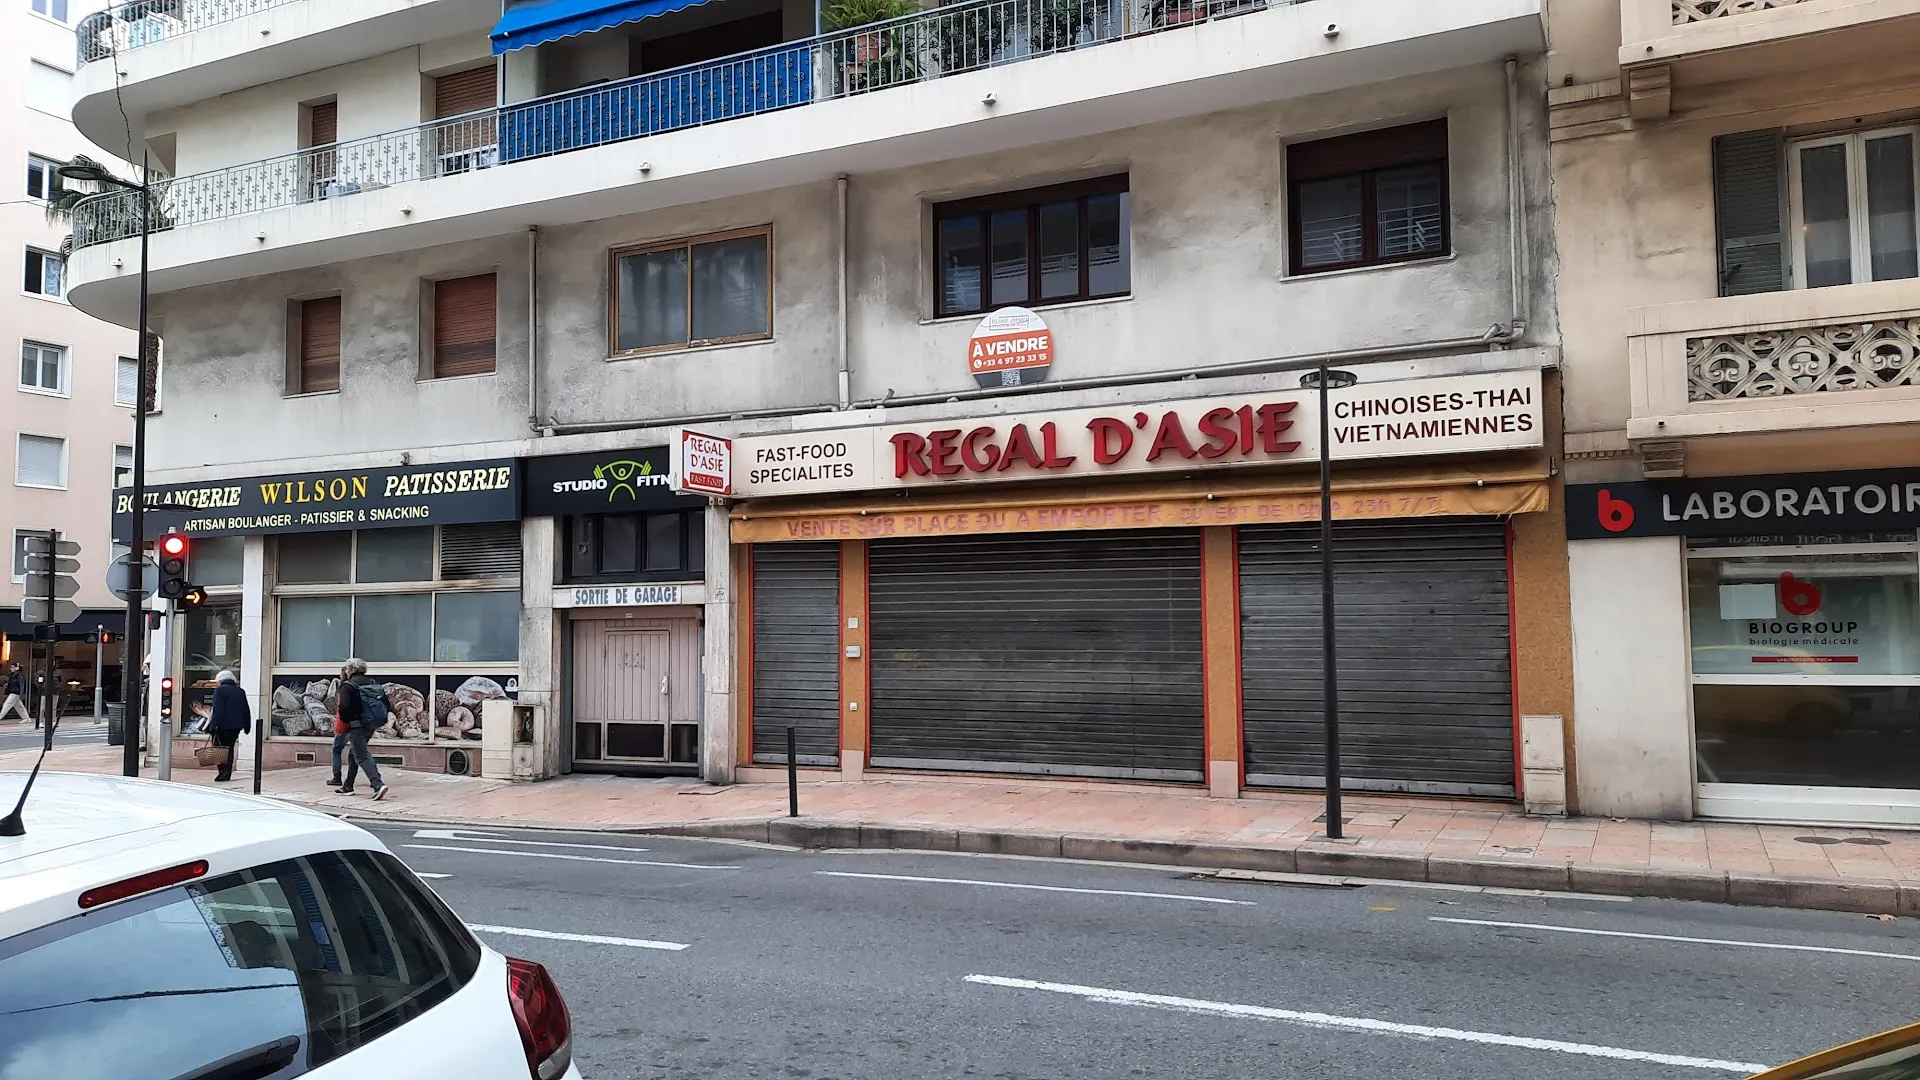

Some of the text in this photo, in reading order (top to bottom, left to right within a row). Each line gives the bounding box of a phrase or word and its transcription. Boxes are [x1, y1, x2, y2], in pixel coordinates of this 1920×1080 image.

[973, 336, 1048, 357] À VENDRE
[1004, 356, 1014, 365] 97
[1027, 354, 1037, 362] 33
[1038, 352, 1047, 361] 15
[1334, 387, 1531, 418] CHINOISES-THAI
[1333, 412, 1533, 444] VIETNAMIENNES
[690, 437, 724, 457] REGAL
[889, 400, 1302, 479] REGAL D'ASIE
[690, 453, 724, 473] D'ASIE
[756, 442, 847, 463] FAST-FOOD
[691, 474, 723, 488] FAST FOOD
[749, 463, 854, 484] SPECIALITES
[260, 477, 367, 504] WILSON
[383, 466, 511, 497] PATISSERIE
[552, 478, 608, 493] STUDIO
[184, 517, 226, 532] ARTISAN
[227, 514, 292, 529] BOULANGER
[300, 509, 354, 525] PATISSIER
[357, 509, 366, 521] &
[369, 504, 430, 521] SNACKING
[787, 519, 851, 536] VENTE
[857, 517, 896, 534] SUR
[903, 513, 969, 532] PLACE
[1016, 510, 1031, 527] A
[1037, 504, 1161, 527] EMPORTER
[1258, 504, 1281, 518] DE
[575, 586, 678, 605] SORTIE DE GARAGE
[1749, 621, 1858, 634] BIOGROUP
[1749, 636, 1859, 646] biologie médicale
